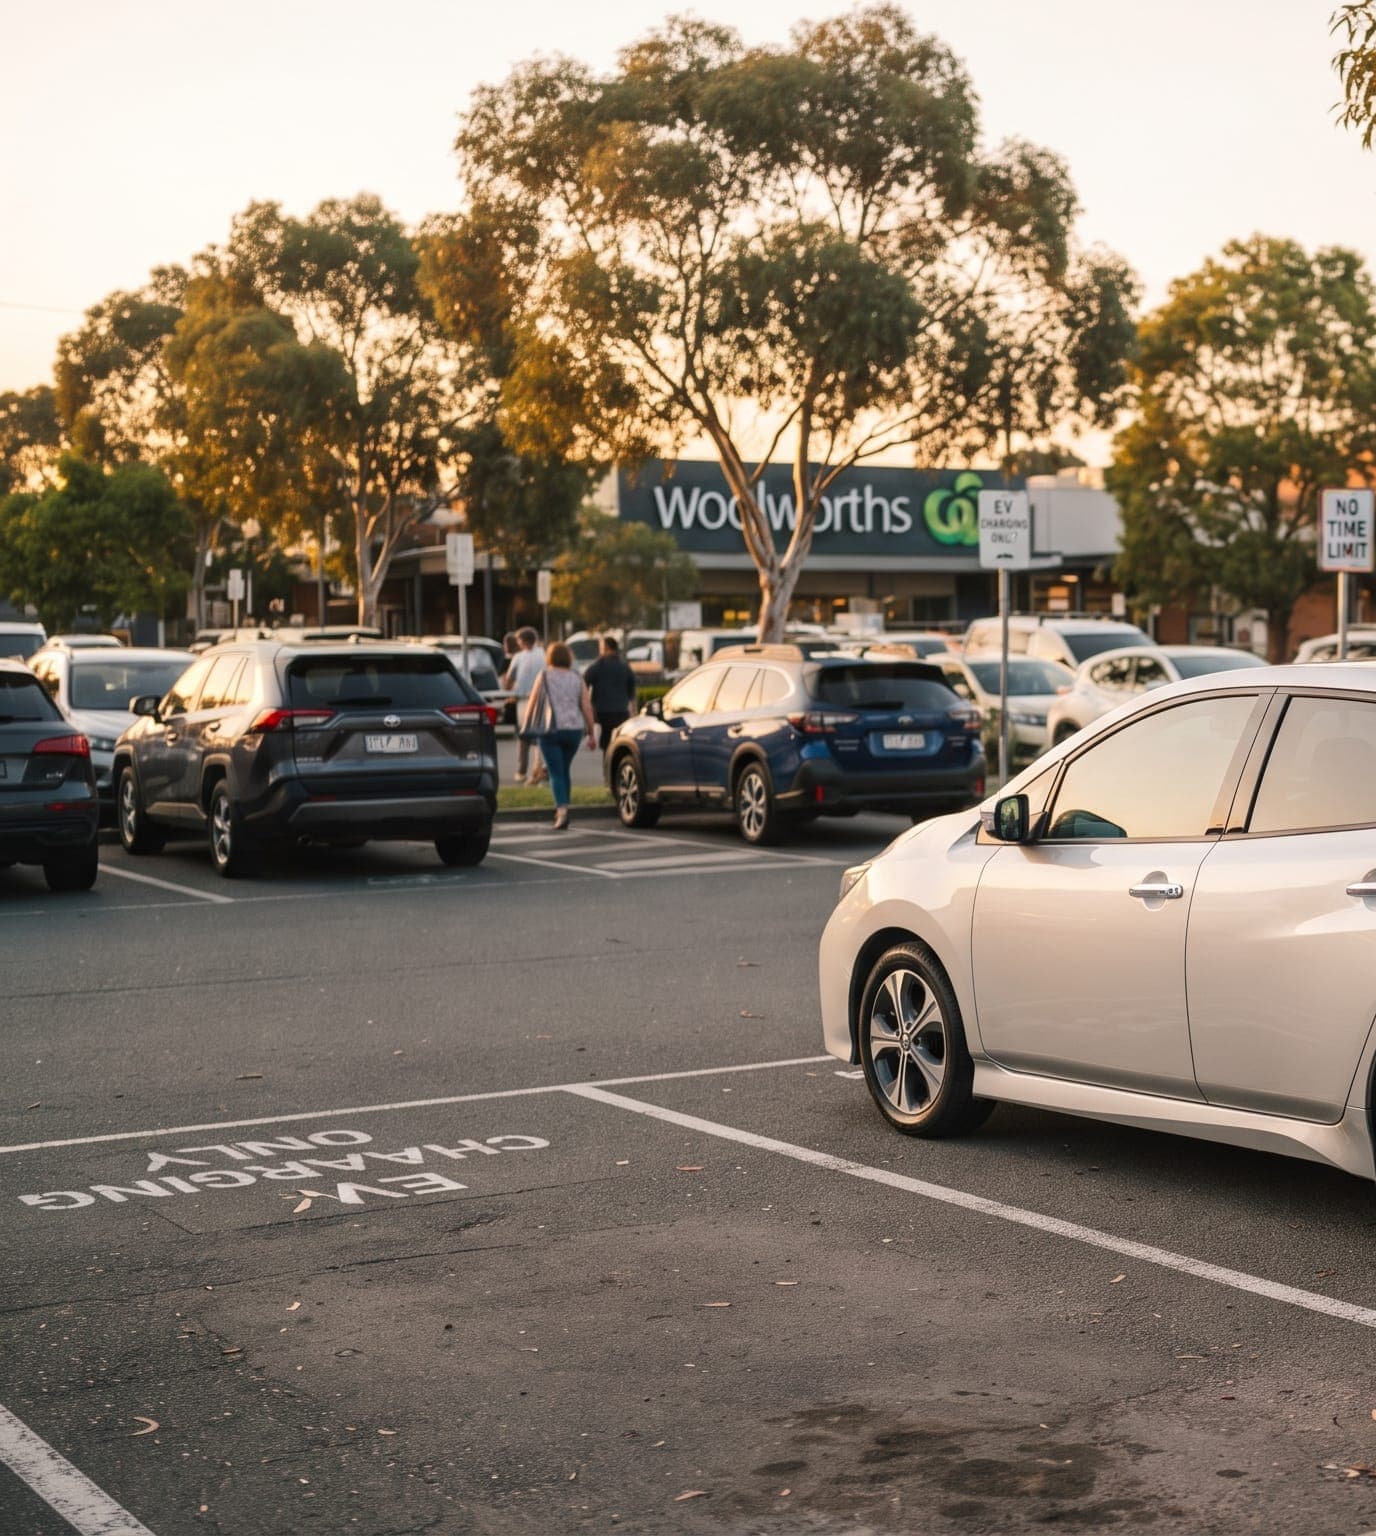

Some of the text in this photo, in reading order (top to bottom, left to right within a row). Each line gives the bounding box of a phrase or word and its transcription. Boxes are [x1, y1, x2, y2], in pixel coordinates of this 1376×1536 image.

[653, 481, 913, 534] Woolworths
[994, 499, 1013, 514] EV
[1336, 498, 1358, 515] NO
[1327, 520, 1367, 537] TIME
[1327, 542, 1368, 559] LIMIT
[146, 1129, 374, 1172] ONLY
[336, 1172, 469, 1205] EV
